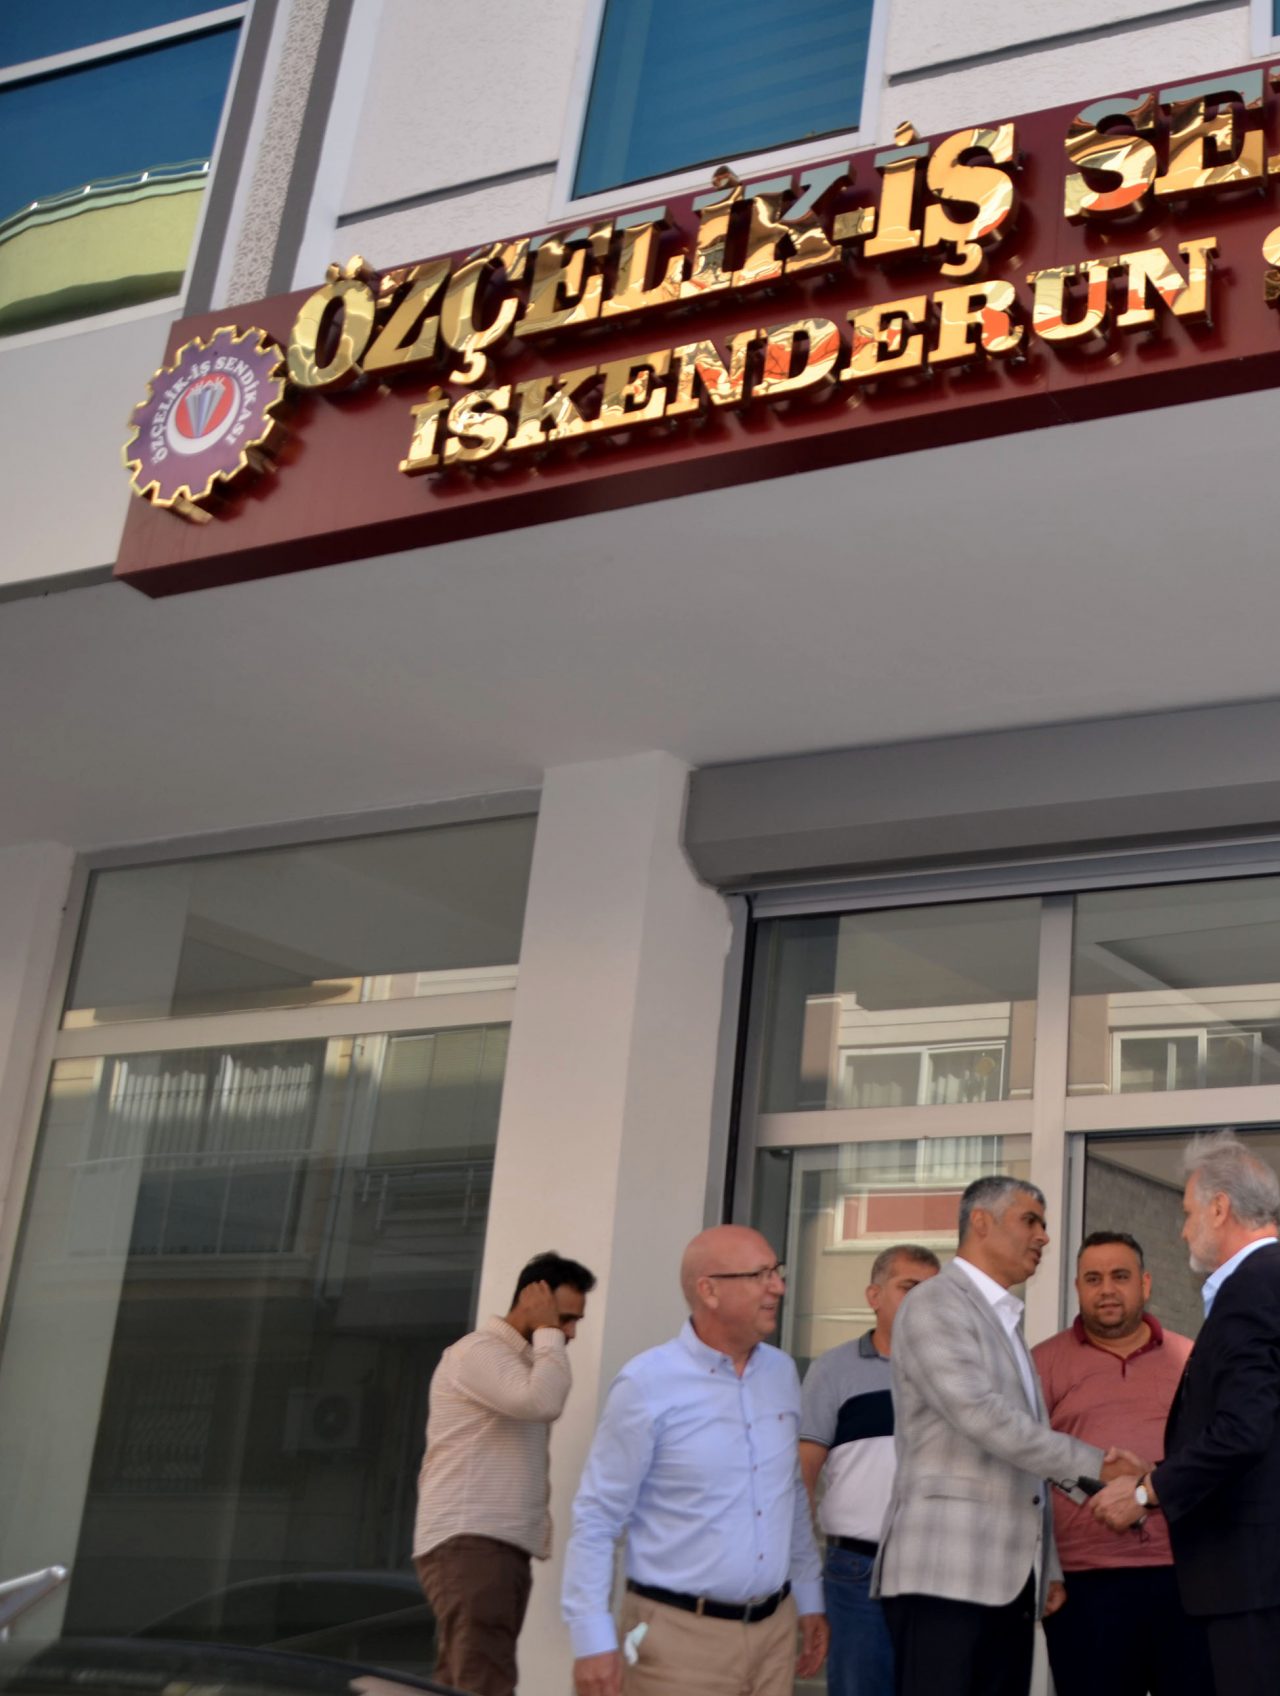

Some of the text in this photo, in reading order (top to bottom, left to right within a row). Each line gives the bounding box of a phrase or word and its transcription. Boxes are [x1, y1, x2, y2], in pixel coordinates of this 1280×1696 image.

[288, 121, 1018, 388] ÖZÇELİK-İŞ
[398, 237, 1219, 475] İSKENDERUN
[151, 355, 261, 465] ÖZÇELİK-İŞ SENDİKASI
